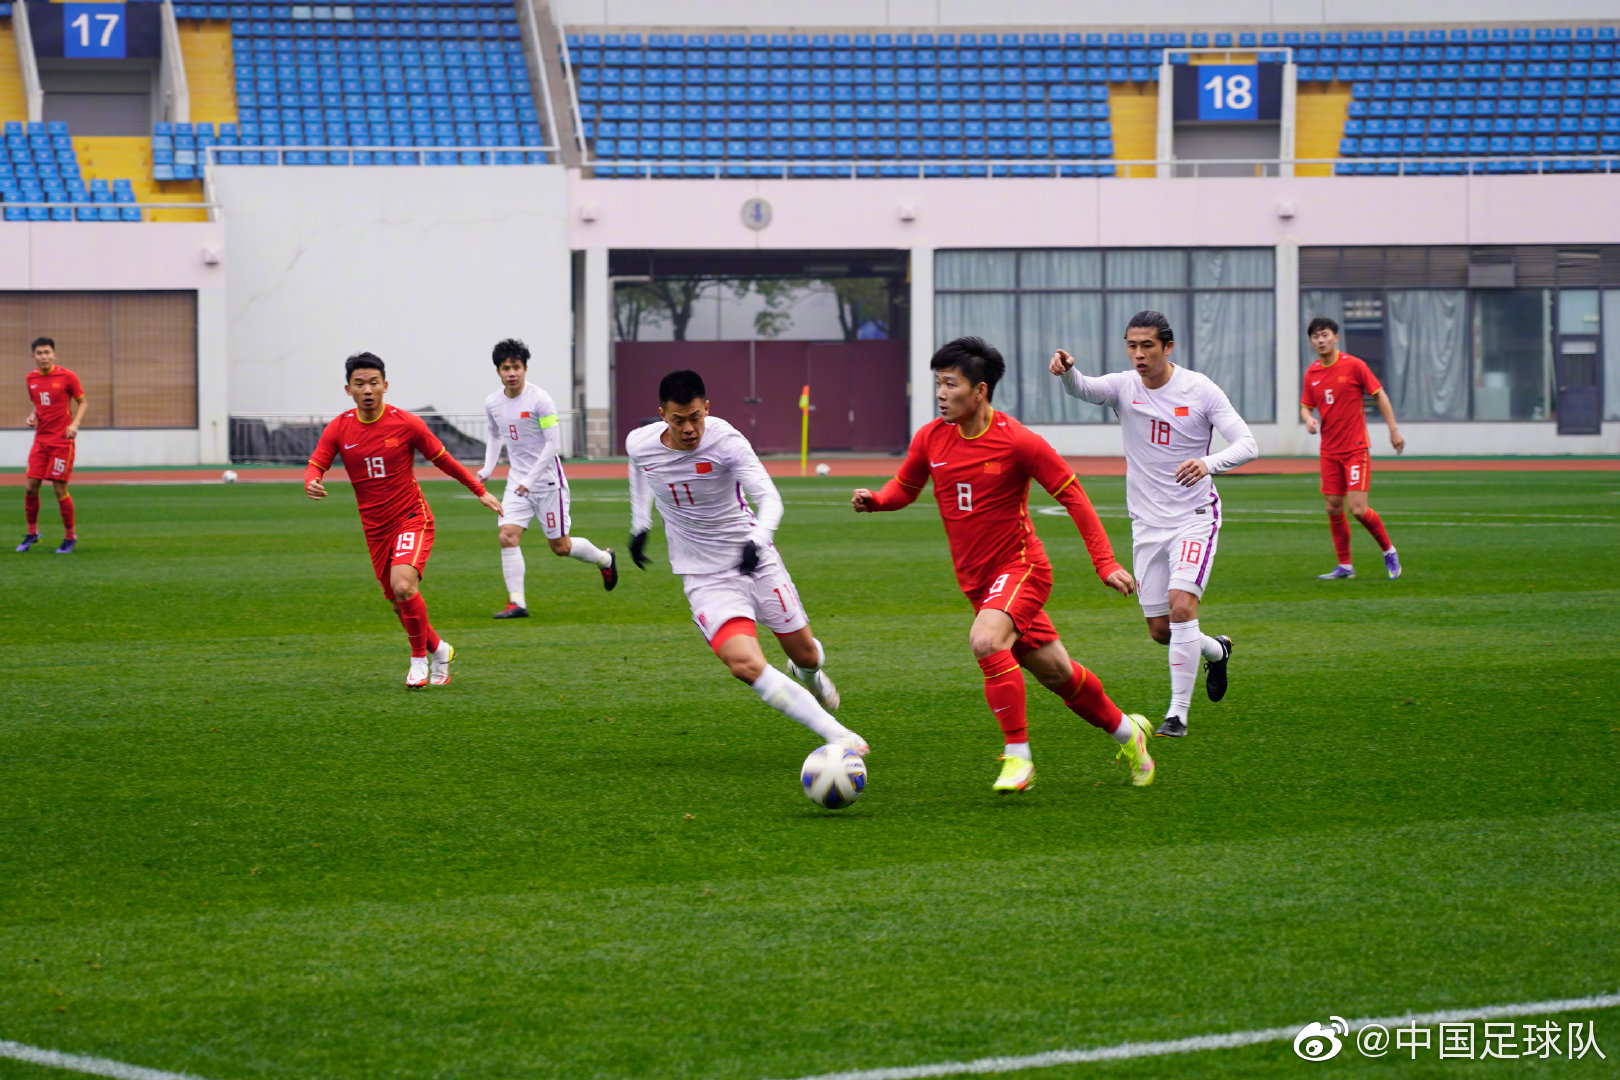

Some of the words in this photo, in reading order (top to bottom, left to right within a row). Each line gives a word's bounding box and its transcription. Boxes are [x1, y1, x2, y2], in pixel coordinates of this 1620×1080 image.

[70, 14, 120, 47] 17
[1205, 75, 1254, 110] 18
[750, 203, 762, 222] 4
[39, 391, 50, 405] 16
[1325, 389, 1334, 405] 6
[509, 424, 519, 441] 8
[1150, 419, 1171, 445] 18
[53, 457, 65, 472] 16
[364, 456, 386, 478] 19
[1350, 466, 1359, 481] 6
[669, 483, 695, 506] 11
[957, 483, 973, 511] 8
[546, 512, 556, 529] 8
[396, 532, 415, 551] 19
[1180, 540, 1202, 565] 18
[990, 574, 1009, 595] 8
[773, 584, 796, 613] 11
